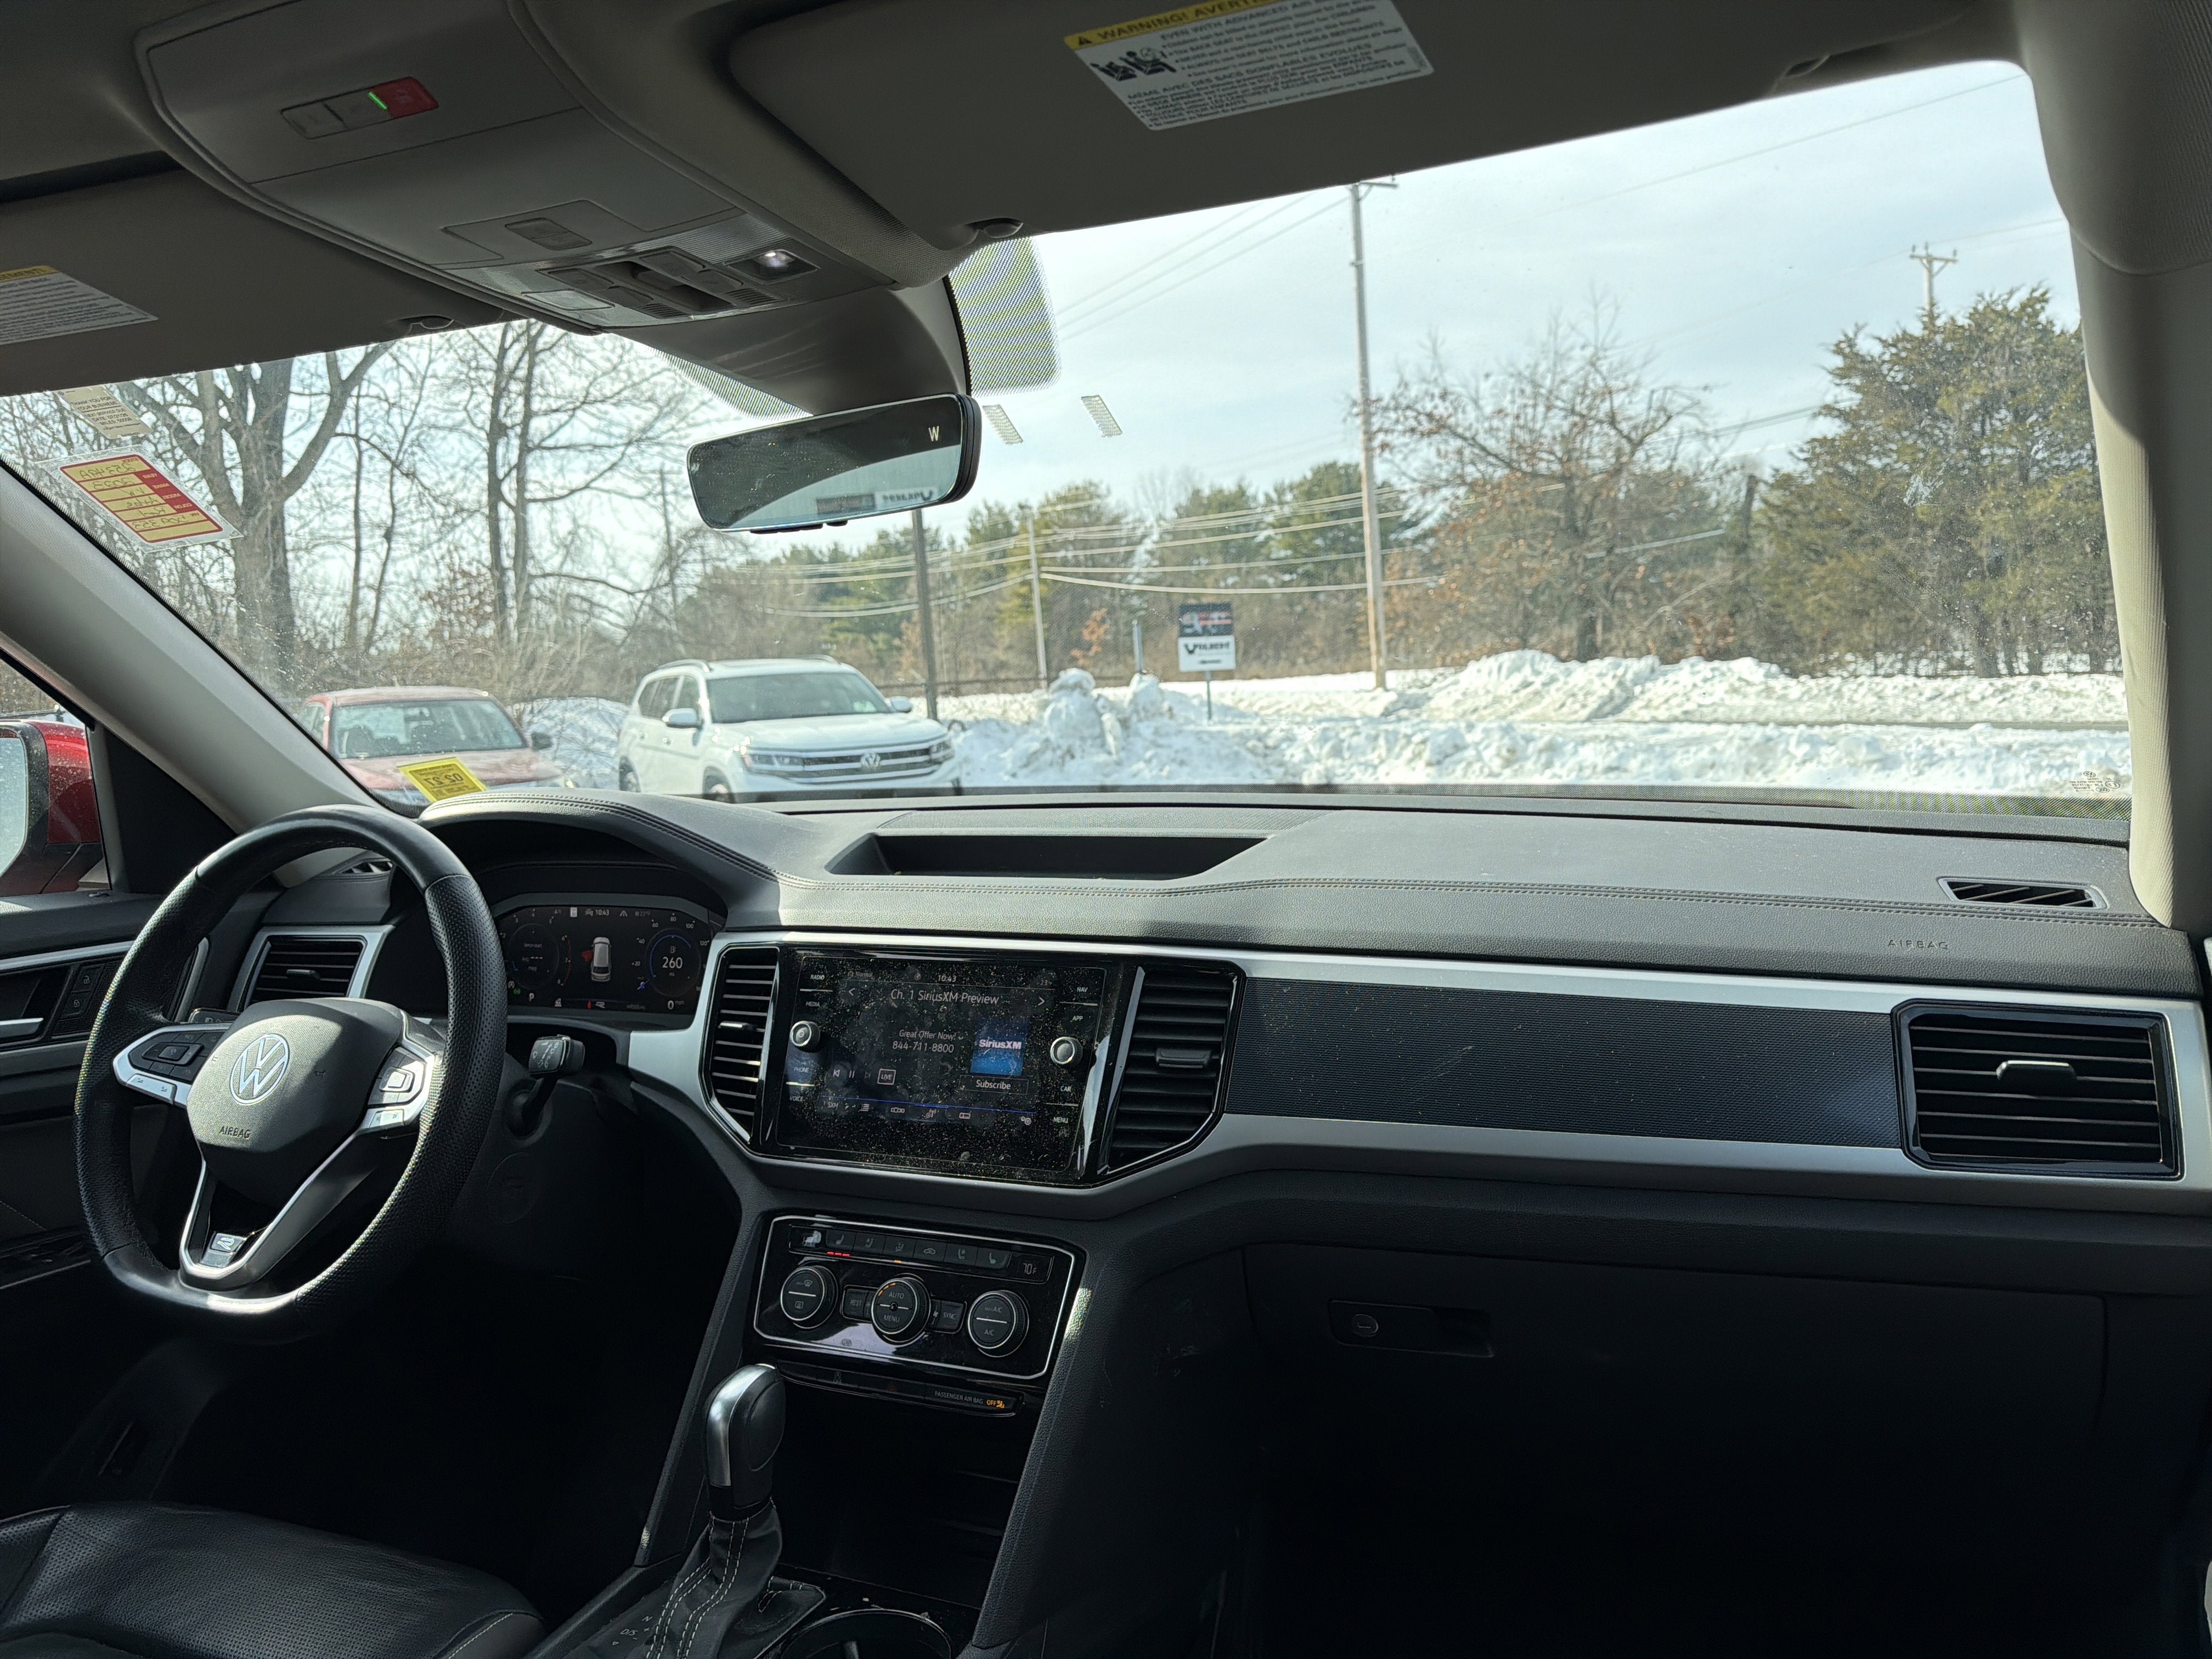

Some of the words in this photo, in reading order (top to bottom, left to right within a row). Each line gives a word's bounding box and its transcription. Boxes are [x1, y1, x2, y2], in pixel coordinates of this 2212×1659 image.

[1098, 12, 1190, 39] WARNING!
[928, 426, 940, 442] W
[1887, 939, 1949, 950] AIRBAG
[662, 956, 684, 969] 260
[937, 974, 957, 983] 10:43
[528, 992, 535, 1002] P
[890, 989, 905, 1001] Ch.
[917, 990, 958, 1003] SiriusXM
[961, 993, 999, 1006] Preview
[667, 999, 675, 1010] 0
[899, 1029, 917, 1038] Great
[918, 1030, 936, 1039] Offer
[938, 1031, 956, 1041] Now!
[892, 1040, 955, 1053] 844-711-8800
[979, 1039, 1022, 1049] SiriusXM
[975, 1079, 1012, 1090] Subscribe
[218, 1125, 251, 1139] AIRBAG
[888, 1291, 905, 1300] AUTO
[883, 1314, 900, 1323] MENU
[943, 1312, 956, 1320] SYNC
[934, 1390, 963, 1401] PASSENGER
[973, 1396, 984, 1404] BAG
[985, 1399, 997, 1407] OFF
[619, 1628, 639, 1637] D/S
